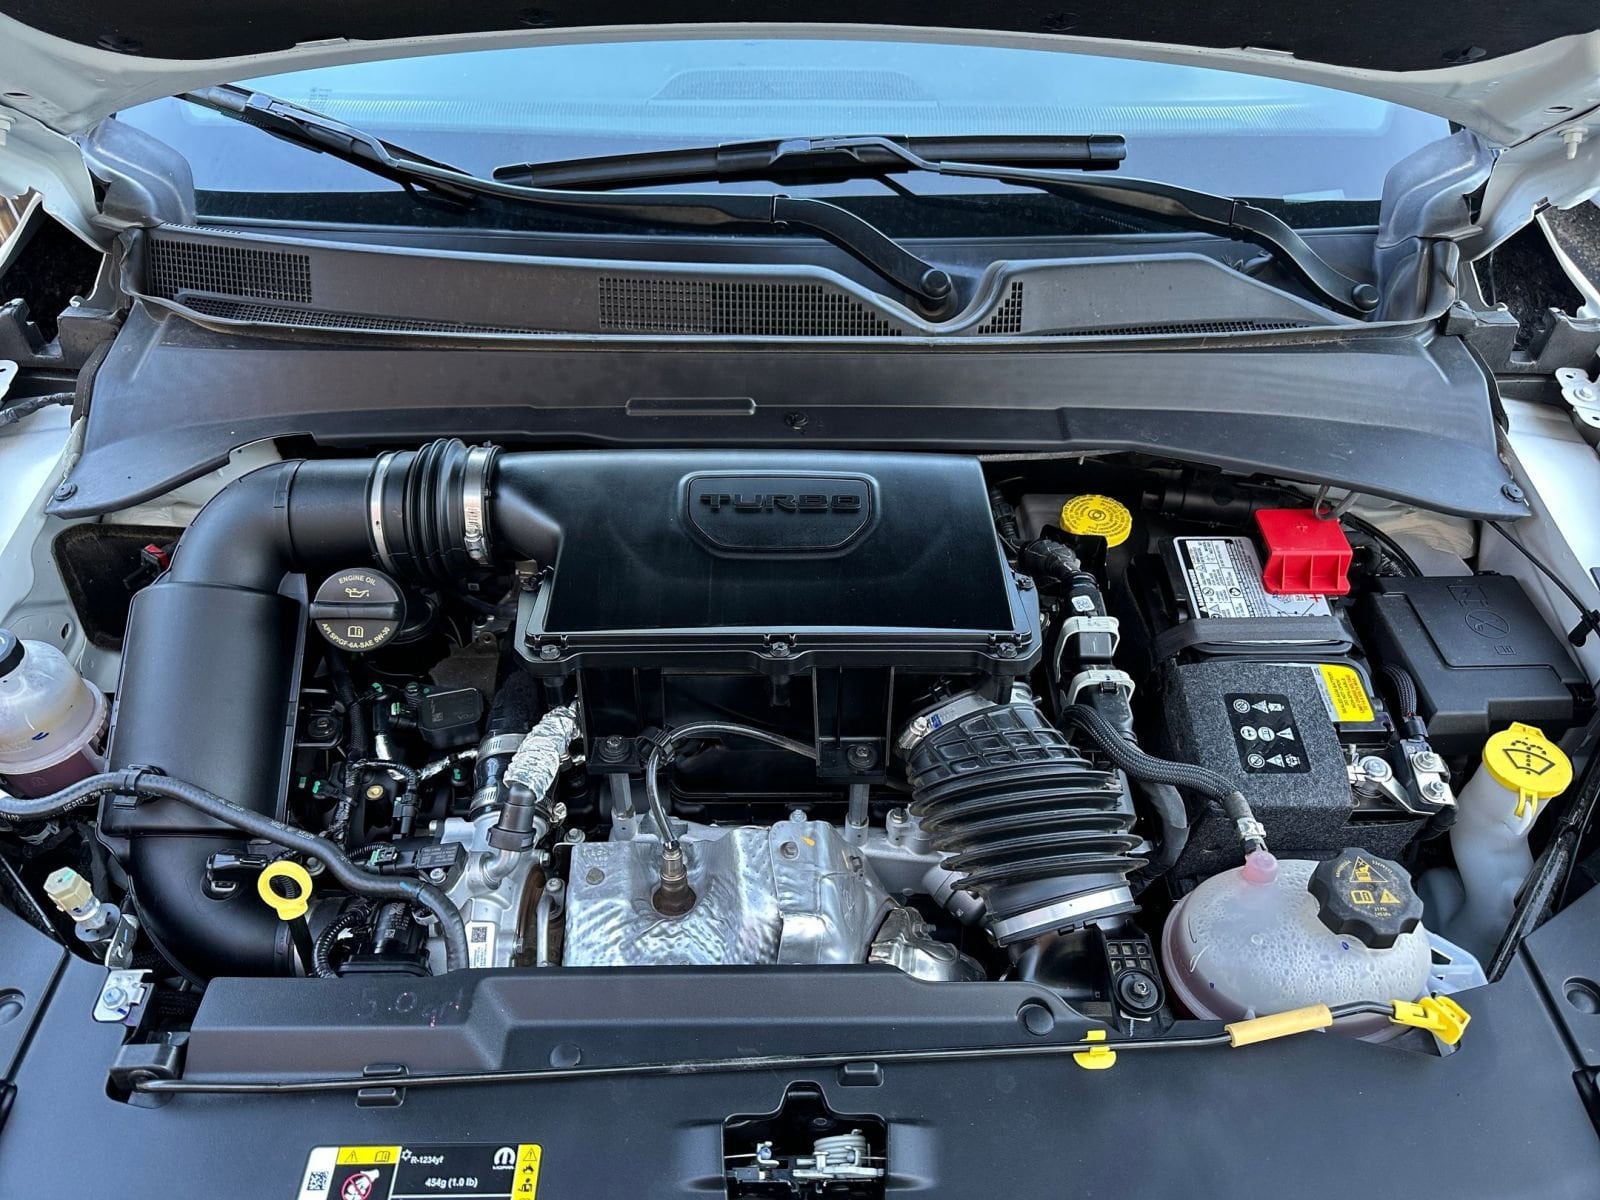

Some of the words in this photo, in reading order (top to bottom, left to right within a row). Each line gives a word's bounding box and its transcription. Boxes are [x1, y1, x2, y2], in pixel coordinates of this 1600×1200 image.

[700, 493, 862, 512] TURBO
[338, 575, 365, 585] ENGINE
[365, 576, 377, 586] OIL
[321, 623, 331, 634] API
[373, 626, 391, 643] 5W-30
[410, 1155, 444, 1165] R-1234yf
[424, 1177, 447, 1188] 454g
[447, 1177, 464, 1188] (1.0
[465, 1177, 479, 1188] lb)
